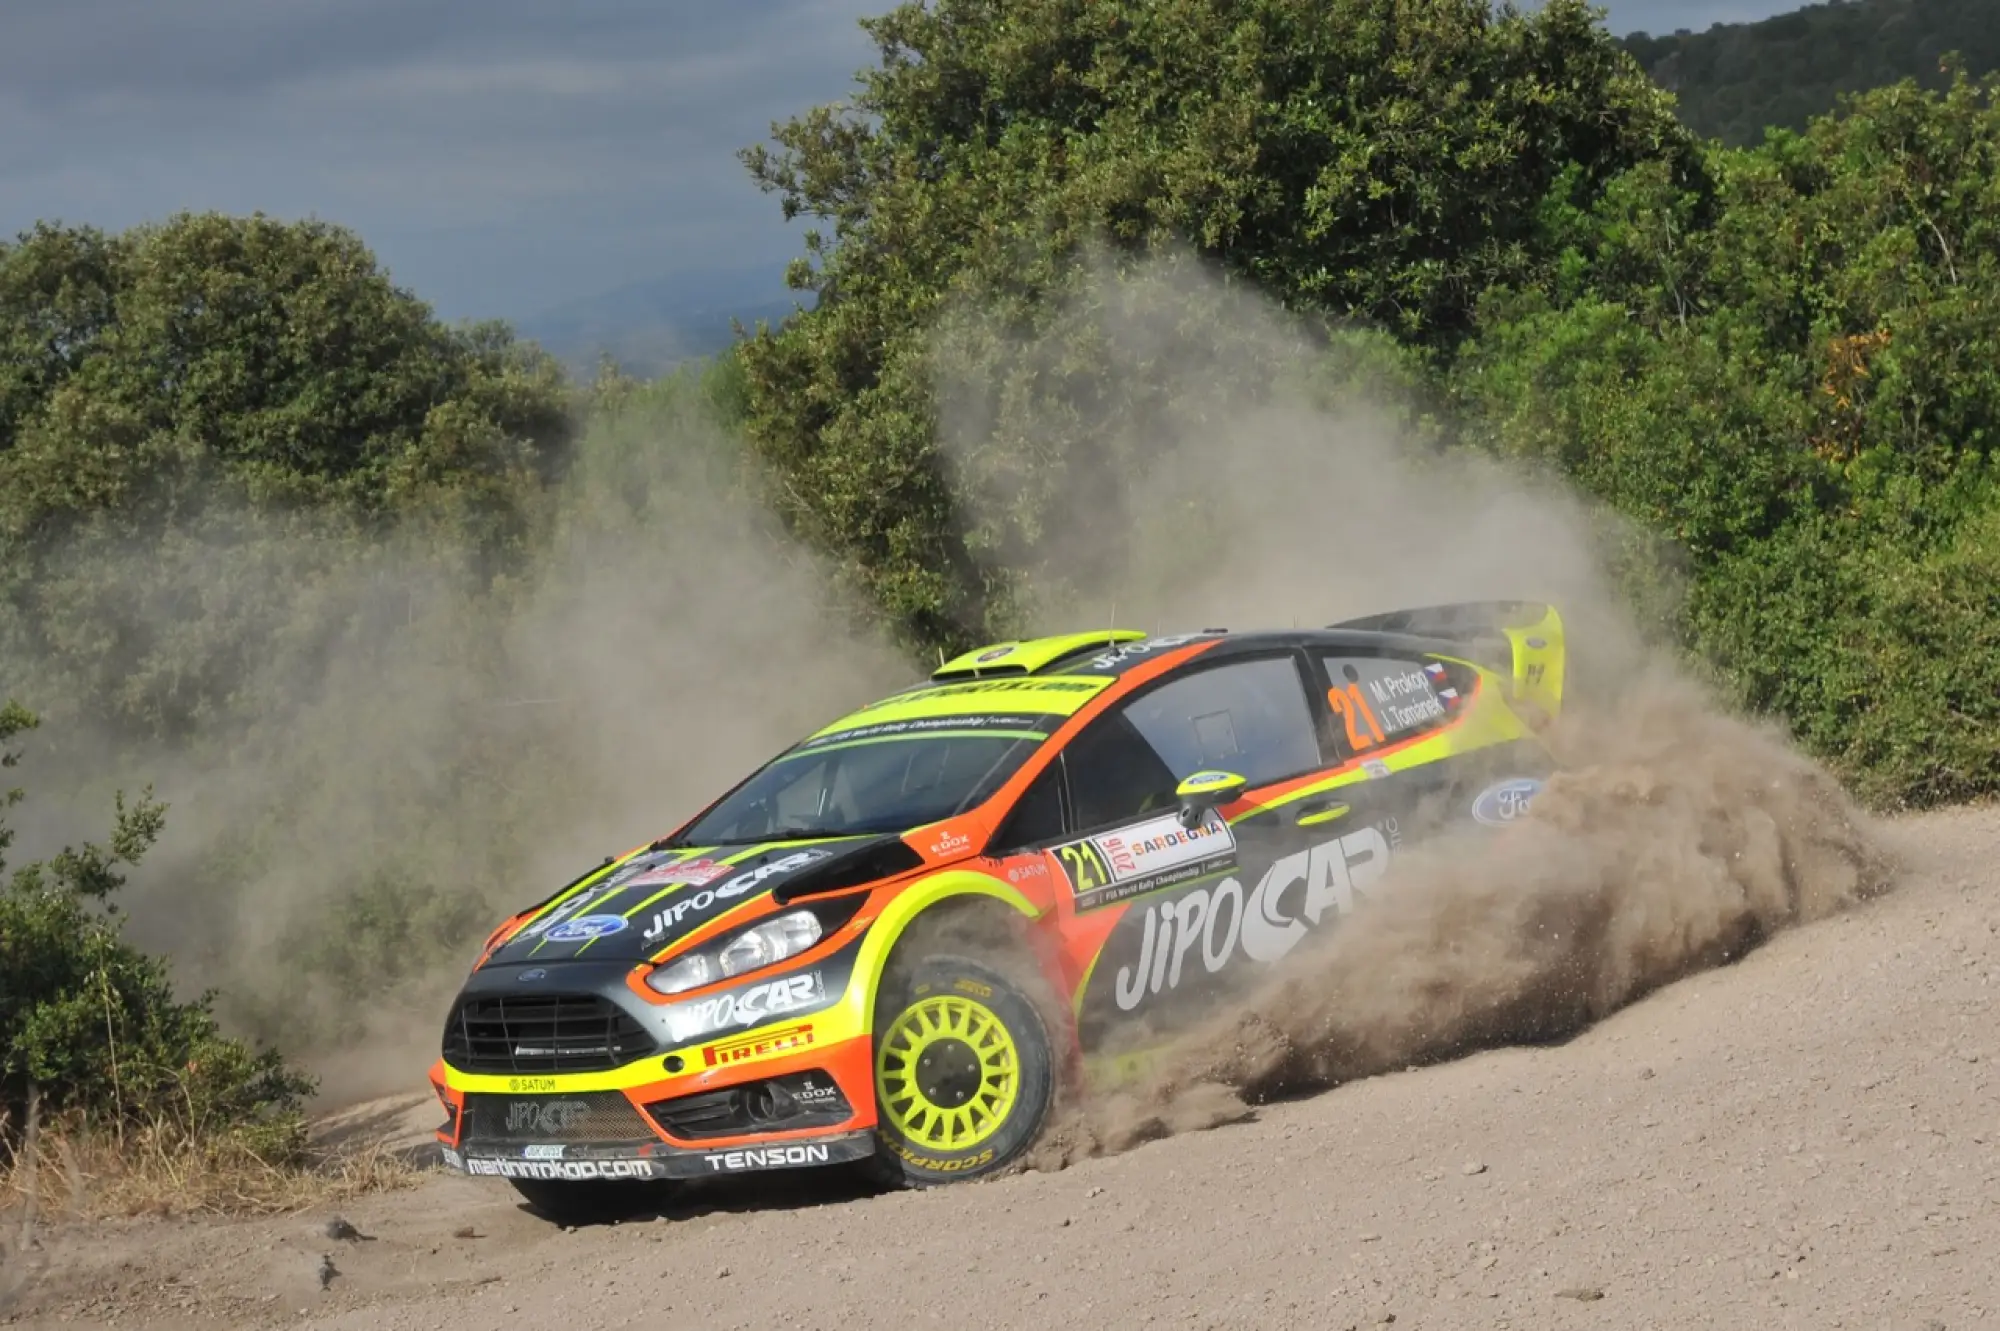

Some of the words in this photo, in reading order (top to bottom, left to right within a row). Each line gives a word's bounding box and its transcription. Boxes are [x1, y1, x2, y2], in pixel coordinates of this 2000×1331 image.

[1369, 679, 1391, 704] M.
[1384, 671, 1432, 701] Prokop
[1327, 682, 1385, 751] 21
[1102, 838, 1136, 874] 2016
[1131, 822, 1223, 856] SARDEGNA
[1061, 841, 1107, 892] 21
[702, 1023, 814, 1067] PIRELLI
[521, 1078, 556, 1091] SATUM
[792, 1085, 837, 1101] EDOX
[704, 1144, 829, 1171] TENSON
